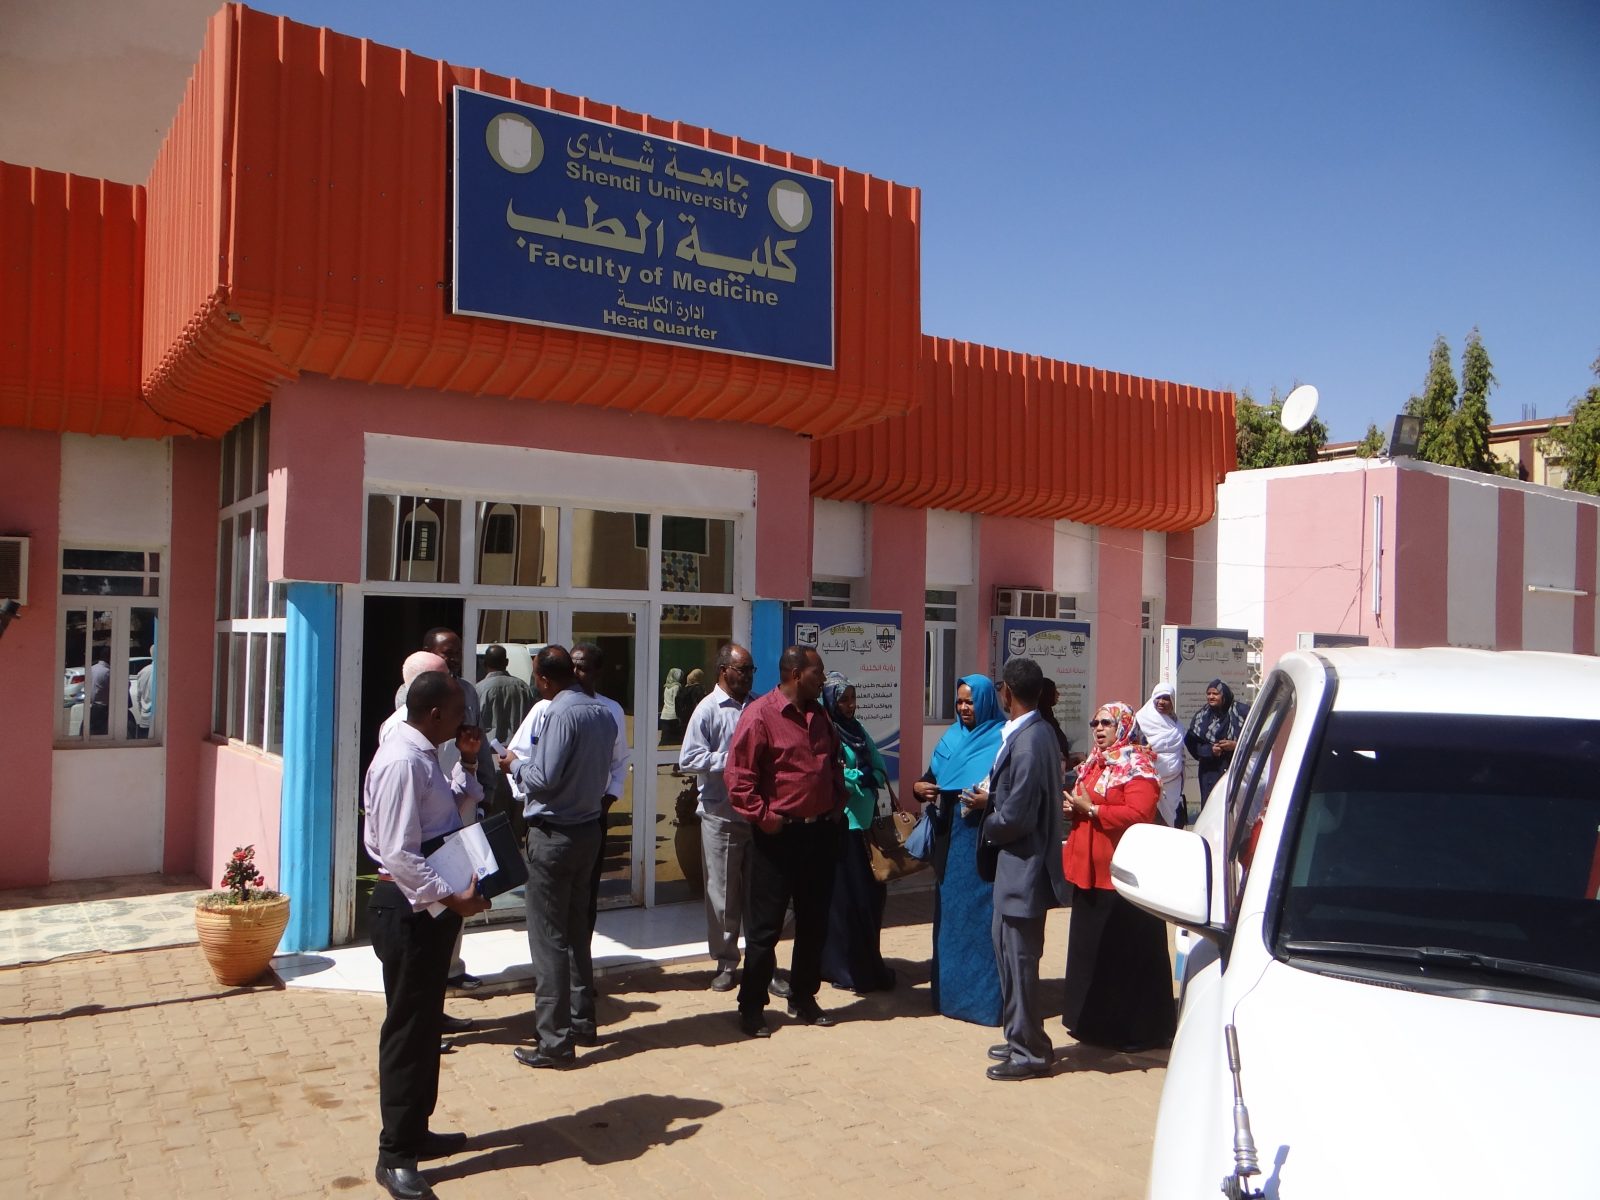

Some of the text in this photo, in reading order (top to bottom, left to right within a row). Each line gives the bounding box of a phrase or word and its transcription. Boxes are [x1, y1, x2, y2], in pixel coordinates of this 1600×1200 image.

[566, 161, 748, 219] Shendi University
[665, 146, 749, 200] جامعة
[506, 195, 797, 283] كلية الطب
[528, 243, 779, 306] Faculty of Medicine
[617, 289, 673, 314] الكلية
[603, 309, 717, 340] Head Quarter
